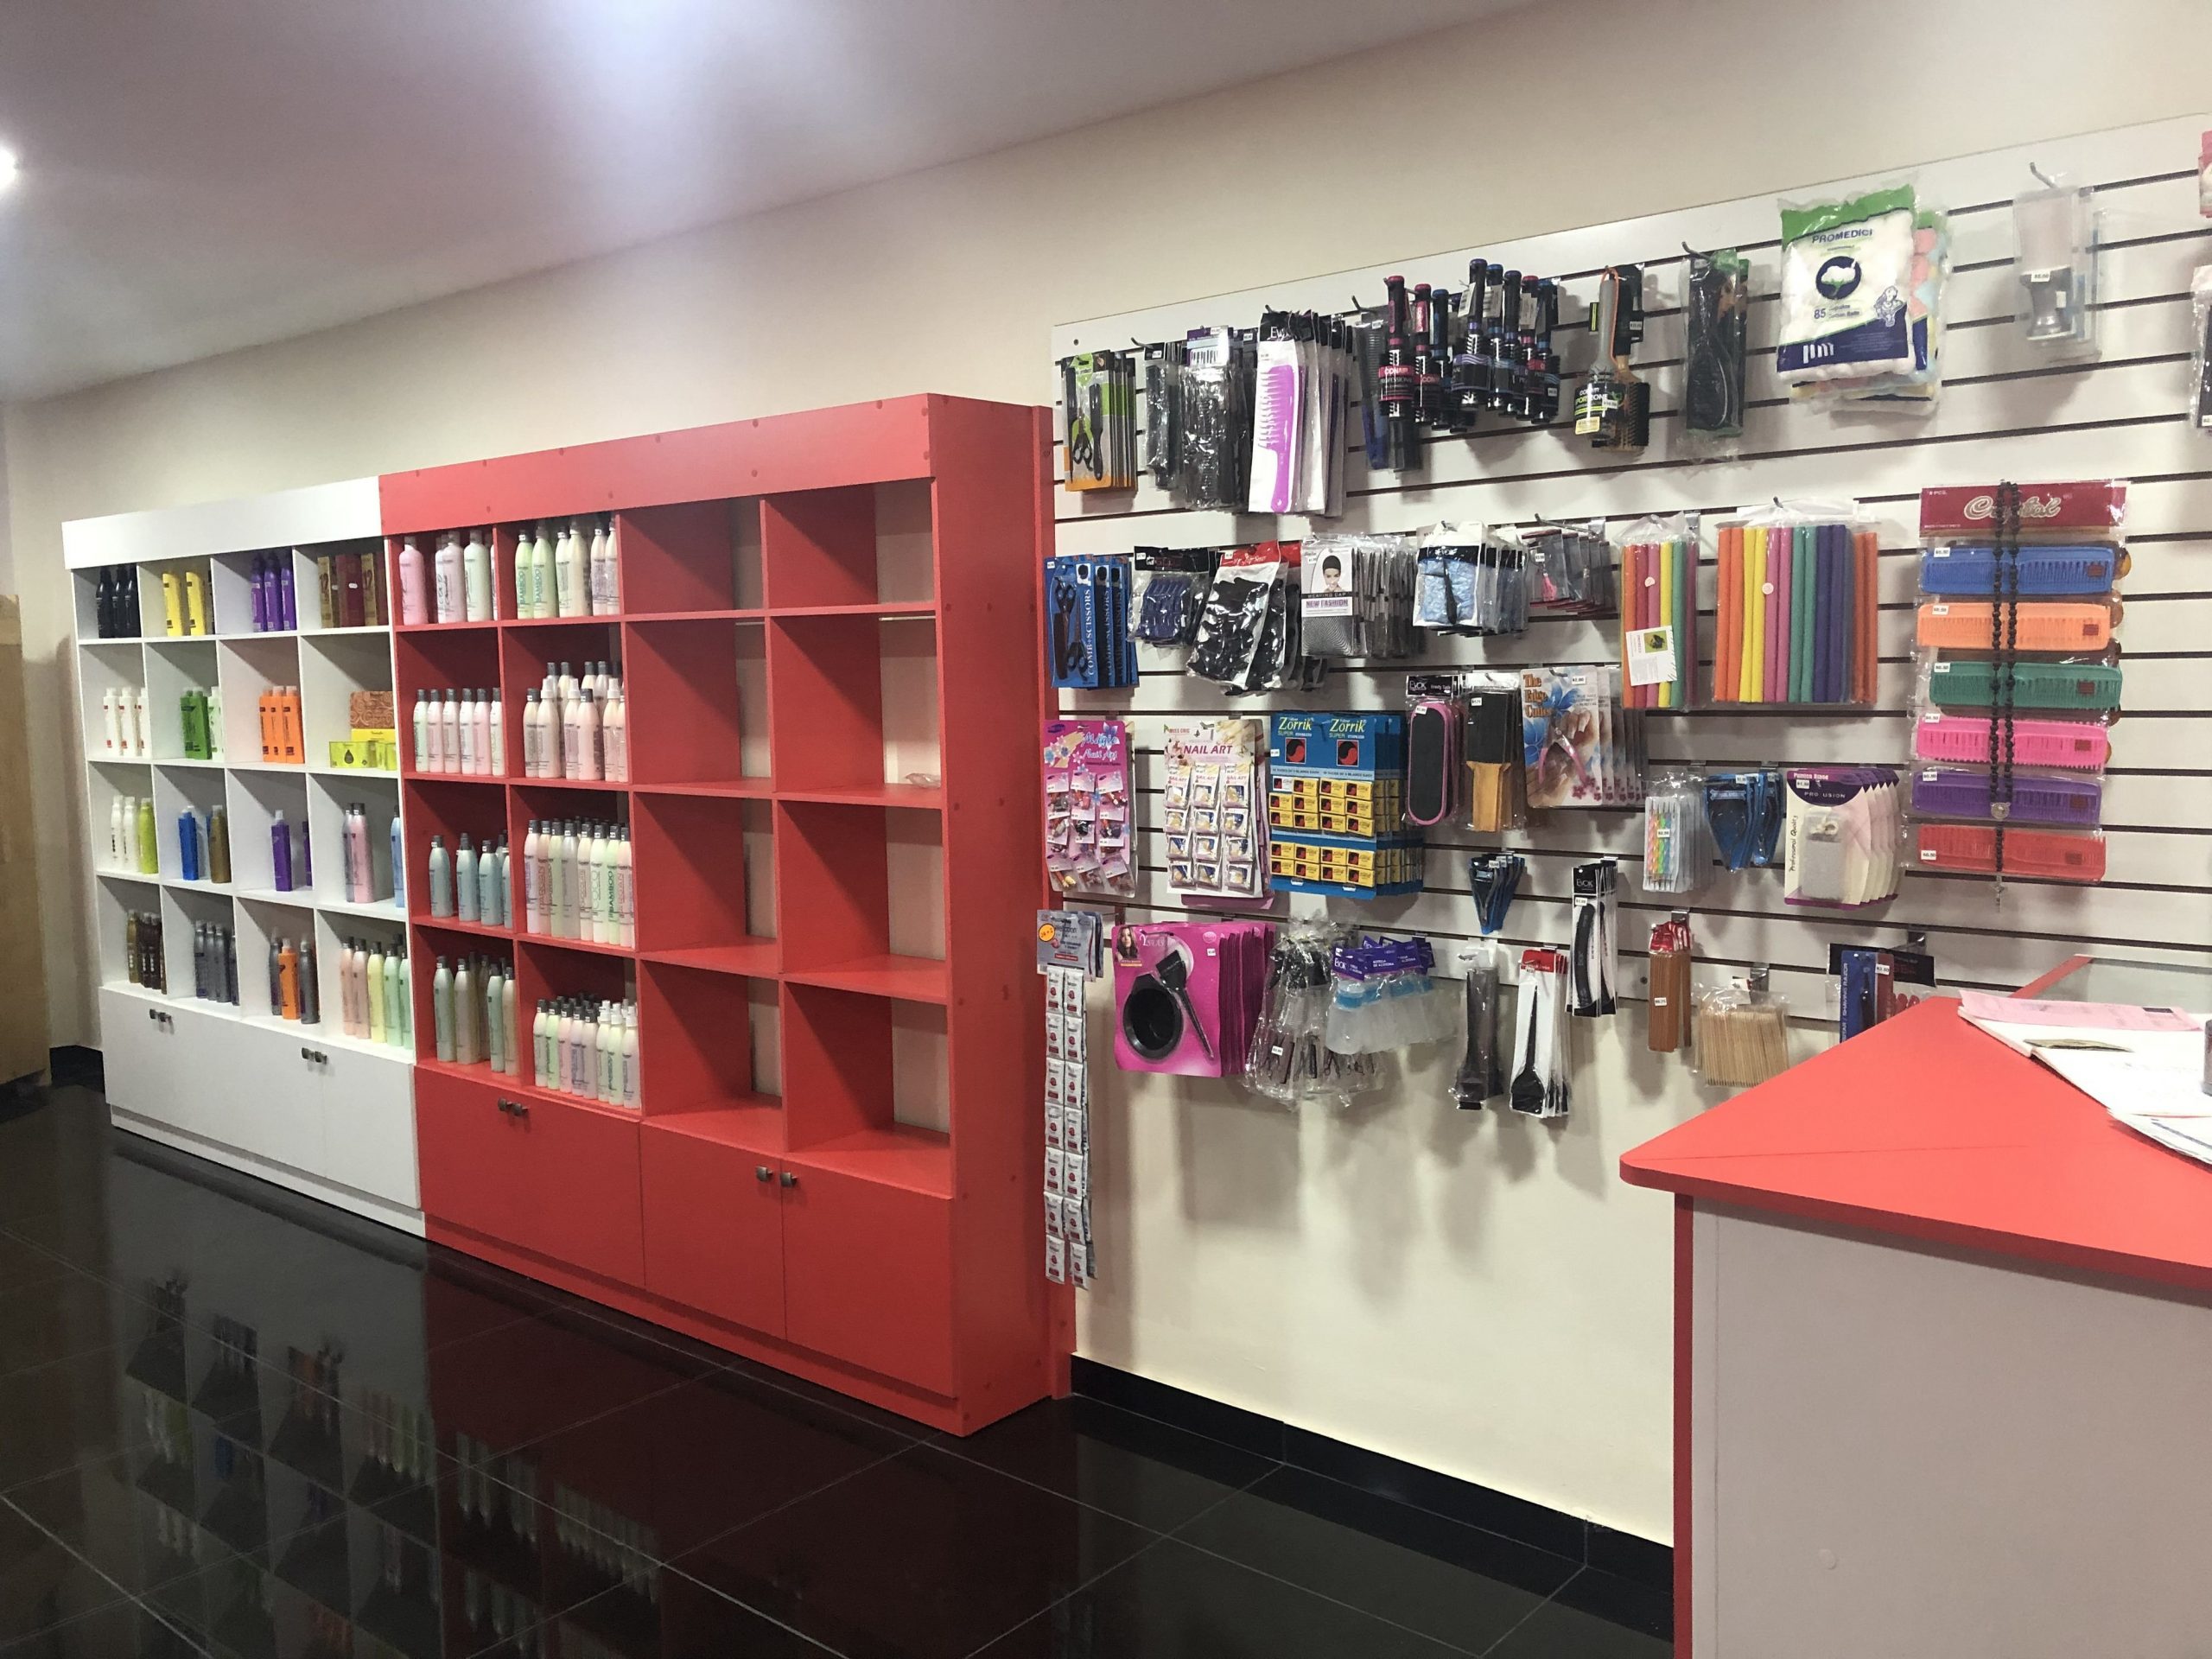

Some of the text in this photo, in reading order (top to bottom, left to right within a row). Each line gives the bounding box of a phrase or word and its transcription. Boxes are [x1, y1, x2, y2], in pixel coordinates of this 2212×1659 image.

[1812, 228, 1872, 244] PROMEDICI
[1814, 308, 1827, 319] 85
[1320, 599, 1348, 608] FASHION
[1084, 589, 1095, 675] COMB+SCISSORS
[1523, 674, 1541, 688] The
[1524, 689, 1548, 707] Edge
[1279, 716, 1312, 731] Zorrik
[1330, 718, 1365, 733] Zorrik
[1184, 745, 1232, 754] NAIL ART
